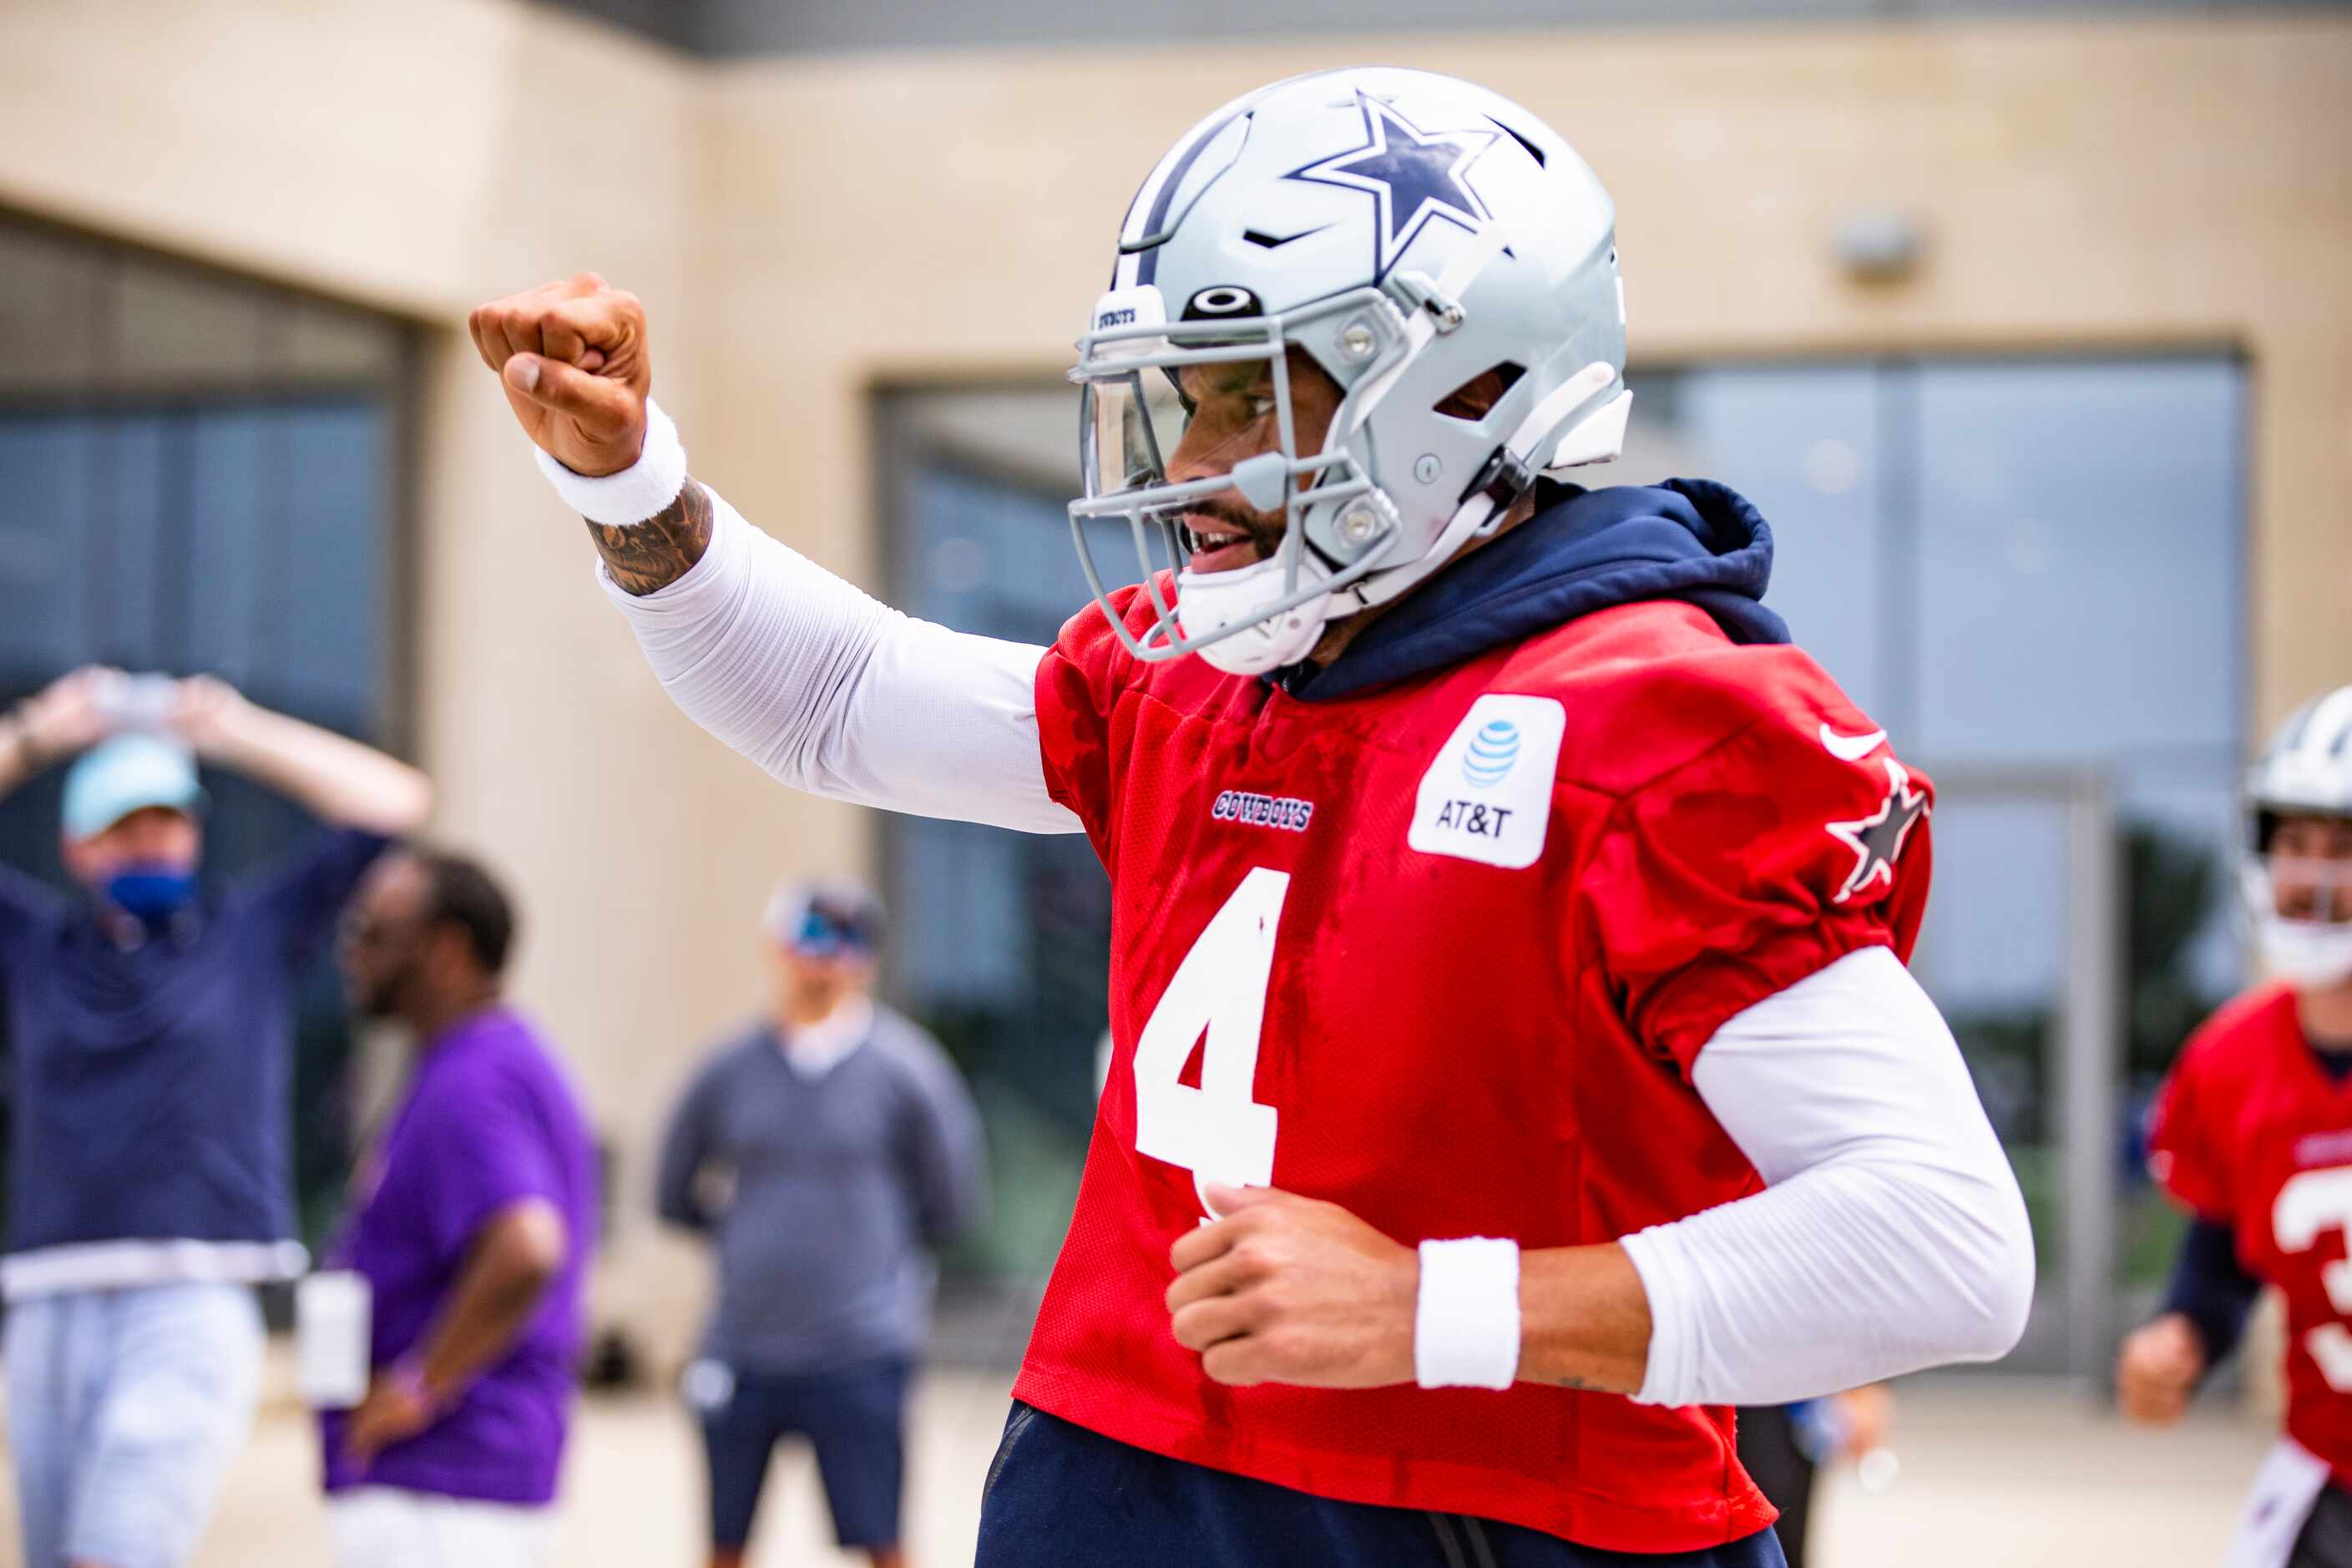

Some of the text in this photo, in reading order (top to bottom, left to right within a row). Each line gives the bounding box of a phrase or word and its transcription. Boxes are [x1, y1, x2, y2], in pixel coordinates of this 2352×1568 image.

[1212, 790, 1313, 832] COWBOYS
[1435, 799, 1513, 837] AT&T
[1133, 866, 1291, 1226] 4
